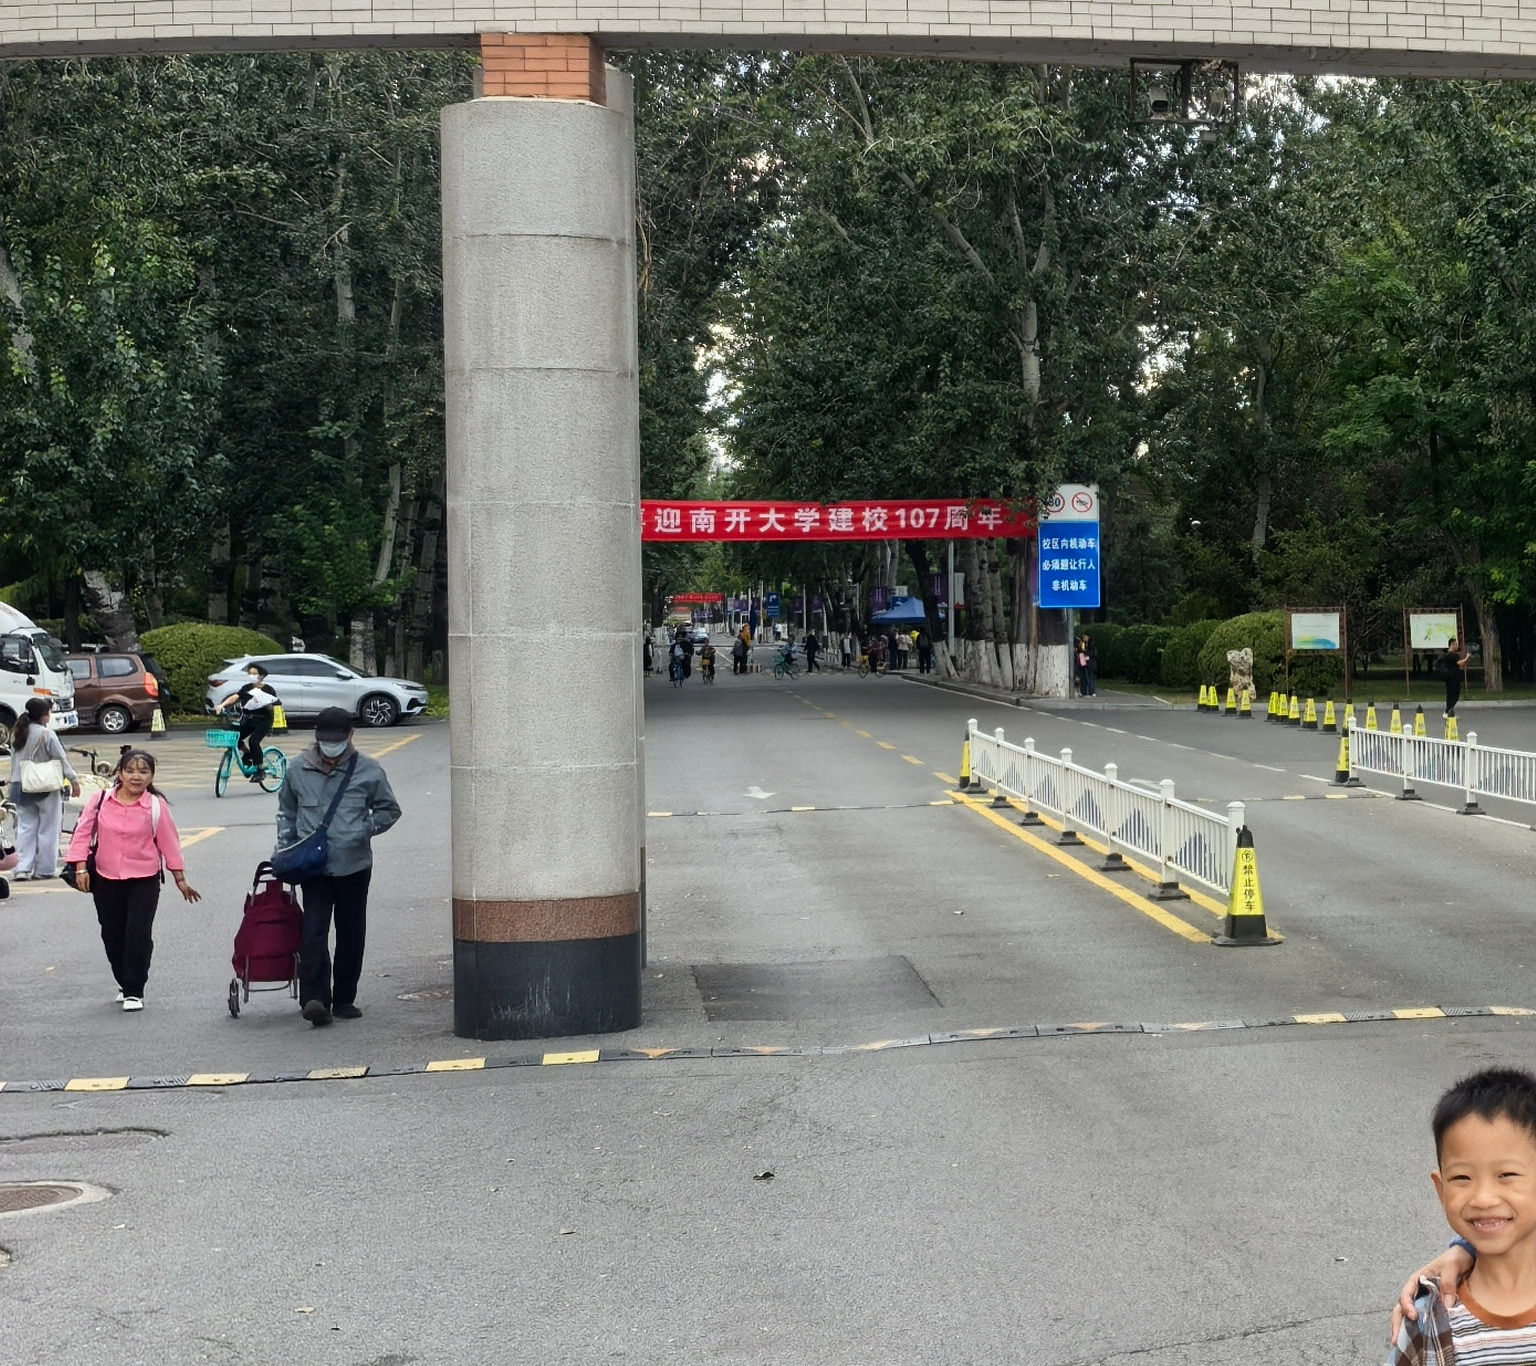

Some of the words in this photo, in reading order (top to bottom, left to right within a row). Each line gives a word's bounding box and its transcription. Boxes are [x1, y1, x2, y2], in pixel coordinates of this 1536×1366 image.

[641, 507, 1003, 533] 迎南开大学建校107周年
[1242, 864, 1255, 911] 禁止停车
